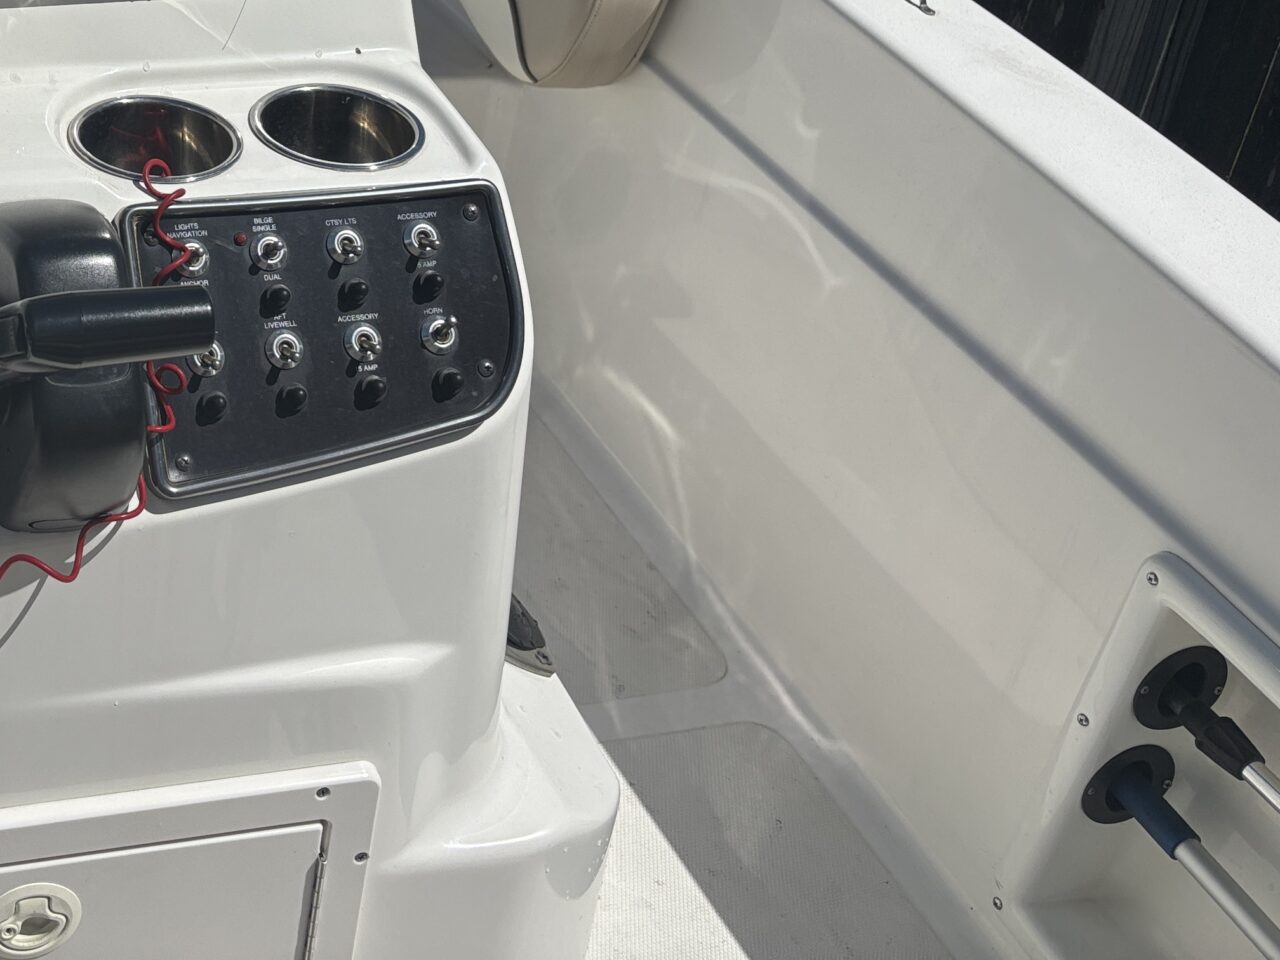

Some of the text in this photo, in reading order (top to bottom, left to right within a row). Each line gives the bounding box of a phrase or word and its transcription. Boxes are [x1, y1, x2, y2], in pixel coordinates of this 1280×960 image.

[397, 211, 437, 221] ACCESSORY
[253, 217, 274, 225] BILGE
[325, 217, 357, 227] CTSY LTS
[174, 222, 199, 231] LIGHTS
[252, 224, 276, 232] SINGLE
[166, 230, 208, 239] NAVIGATION
[263, 273, 282, 281] DUAL
[423, 307, 443, 315] HORN
[337, 312, 379, 323] ACCESSORY
[263, 320, 298, 329] LIVEWELL
